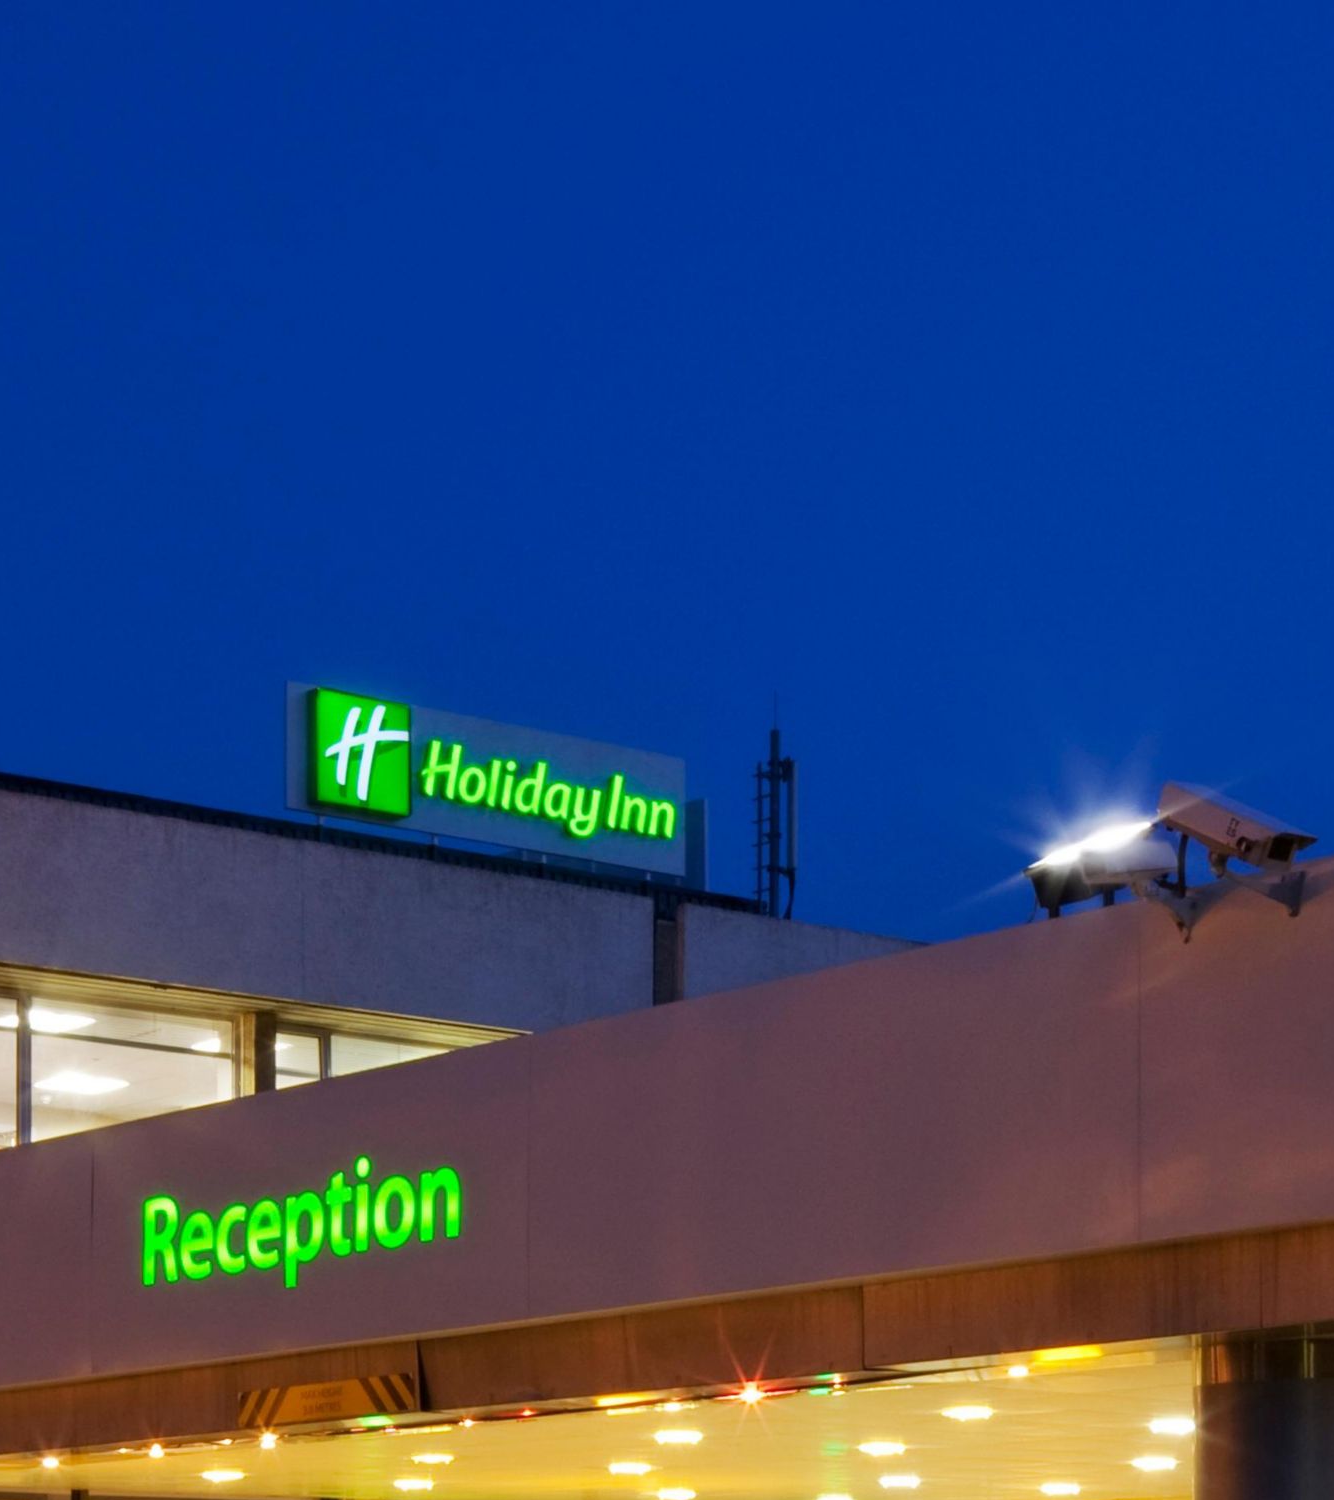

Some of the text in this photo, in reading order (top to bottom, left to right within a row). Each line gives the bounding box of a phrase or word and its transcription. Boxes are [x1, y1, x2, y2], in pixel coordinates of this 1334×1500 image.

[422, 740, 674, 839] Holiday Inn
[142, 1156, 461, 1288] Reception
